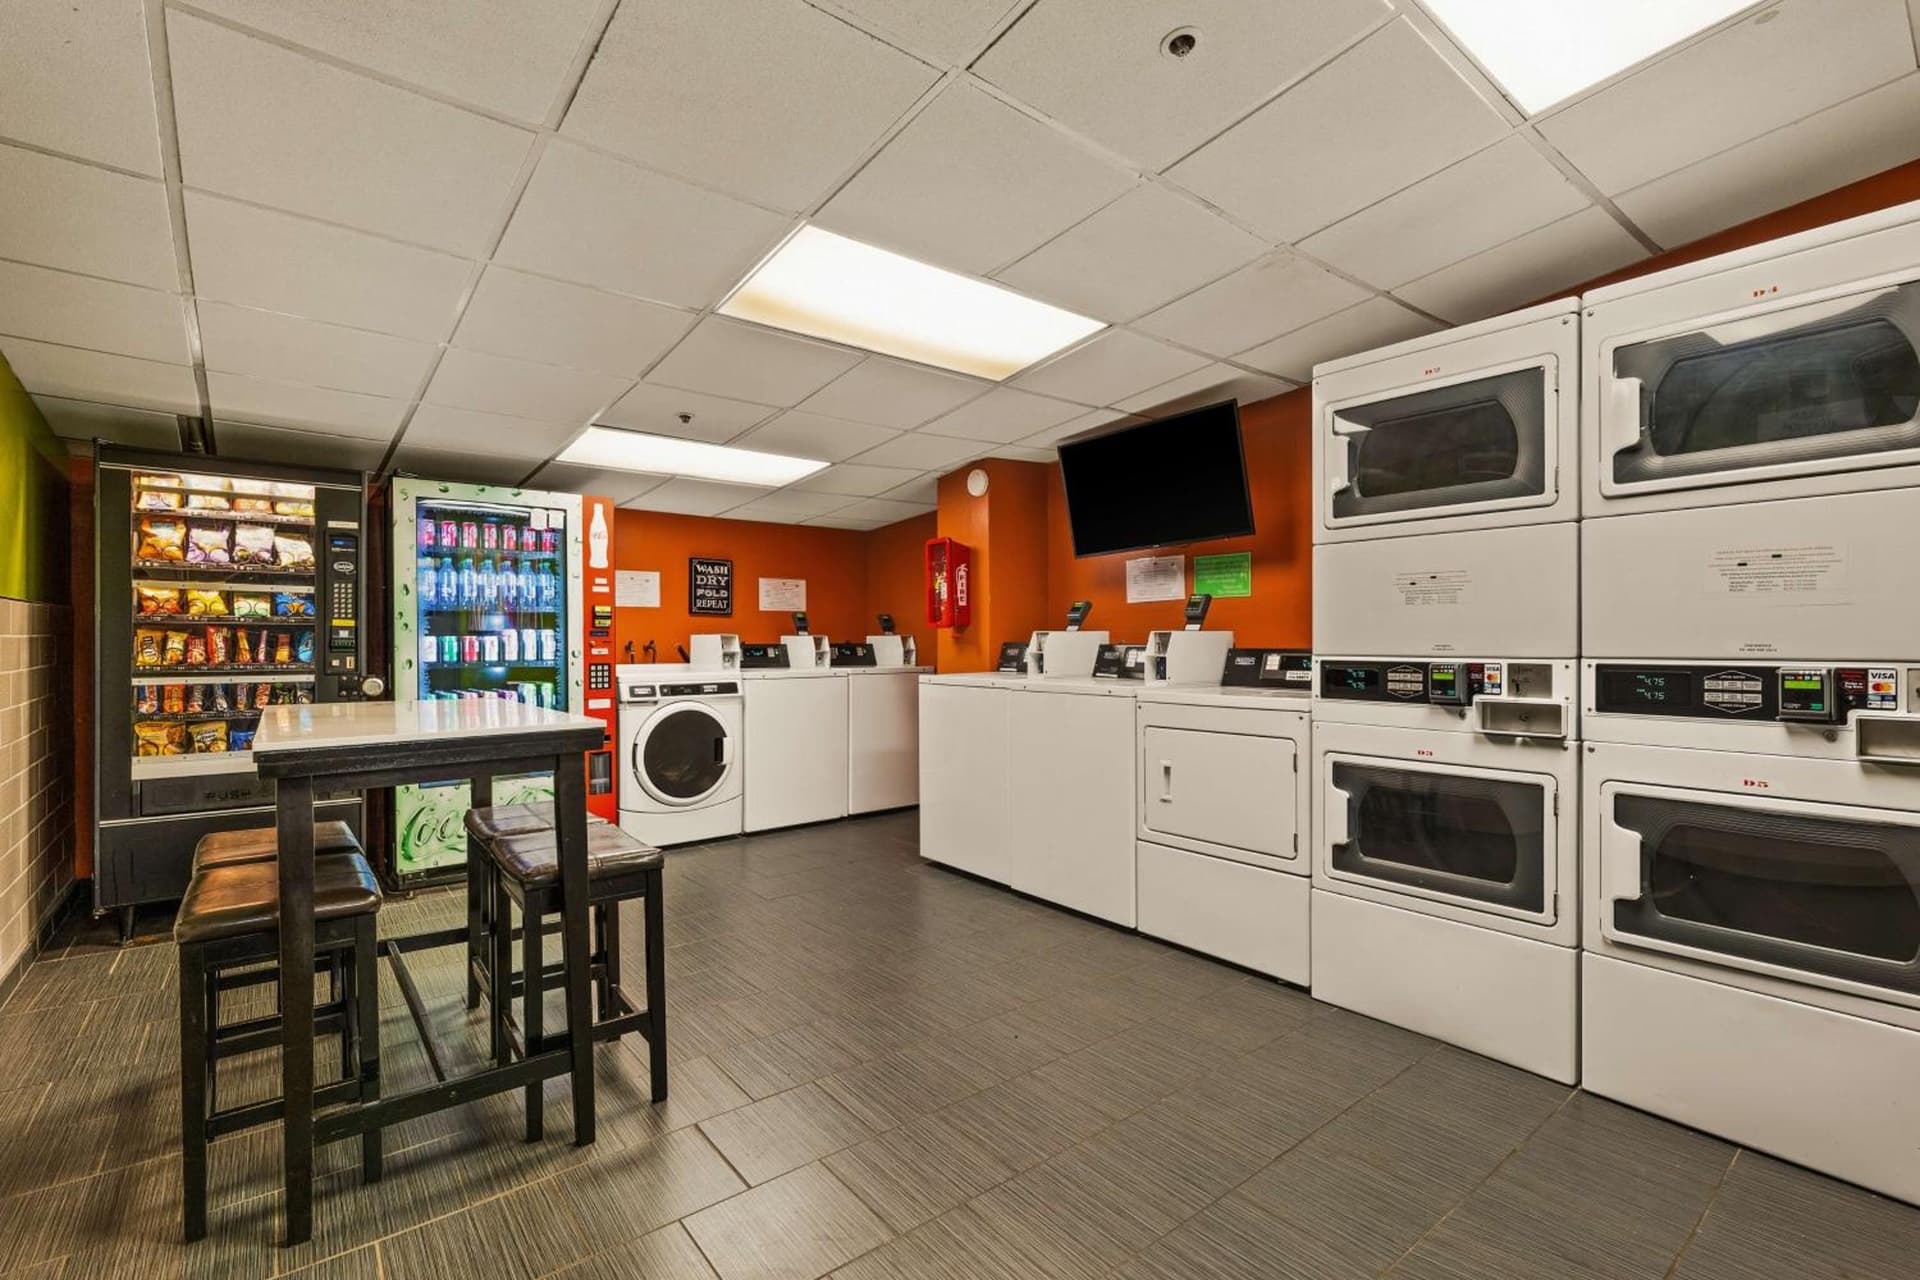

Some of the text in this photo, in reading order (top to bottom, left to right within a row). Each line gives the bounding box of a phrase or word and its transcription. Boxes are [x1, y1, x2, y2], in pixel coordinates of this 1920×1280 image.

[695, 564, 729, 575] WASH
[695, 574, 729, 586] DRY
[695, 588, 729, 598] FOLD
[695, 598, 729, 609] REPEAT
